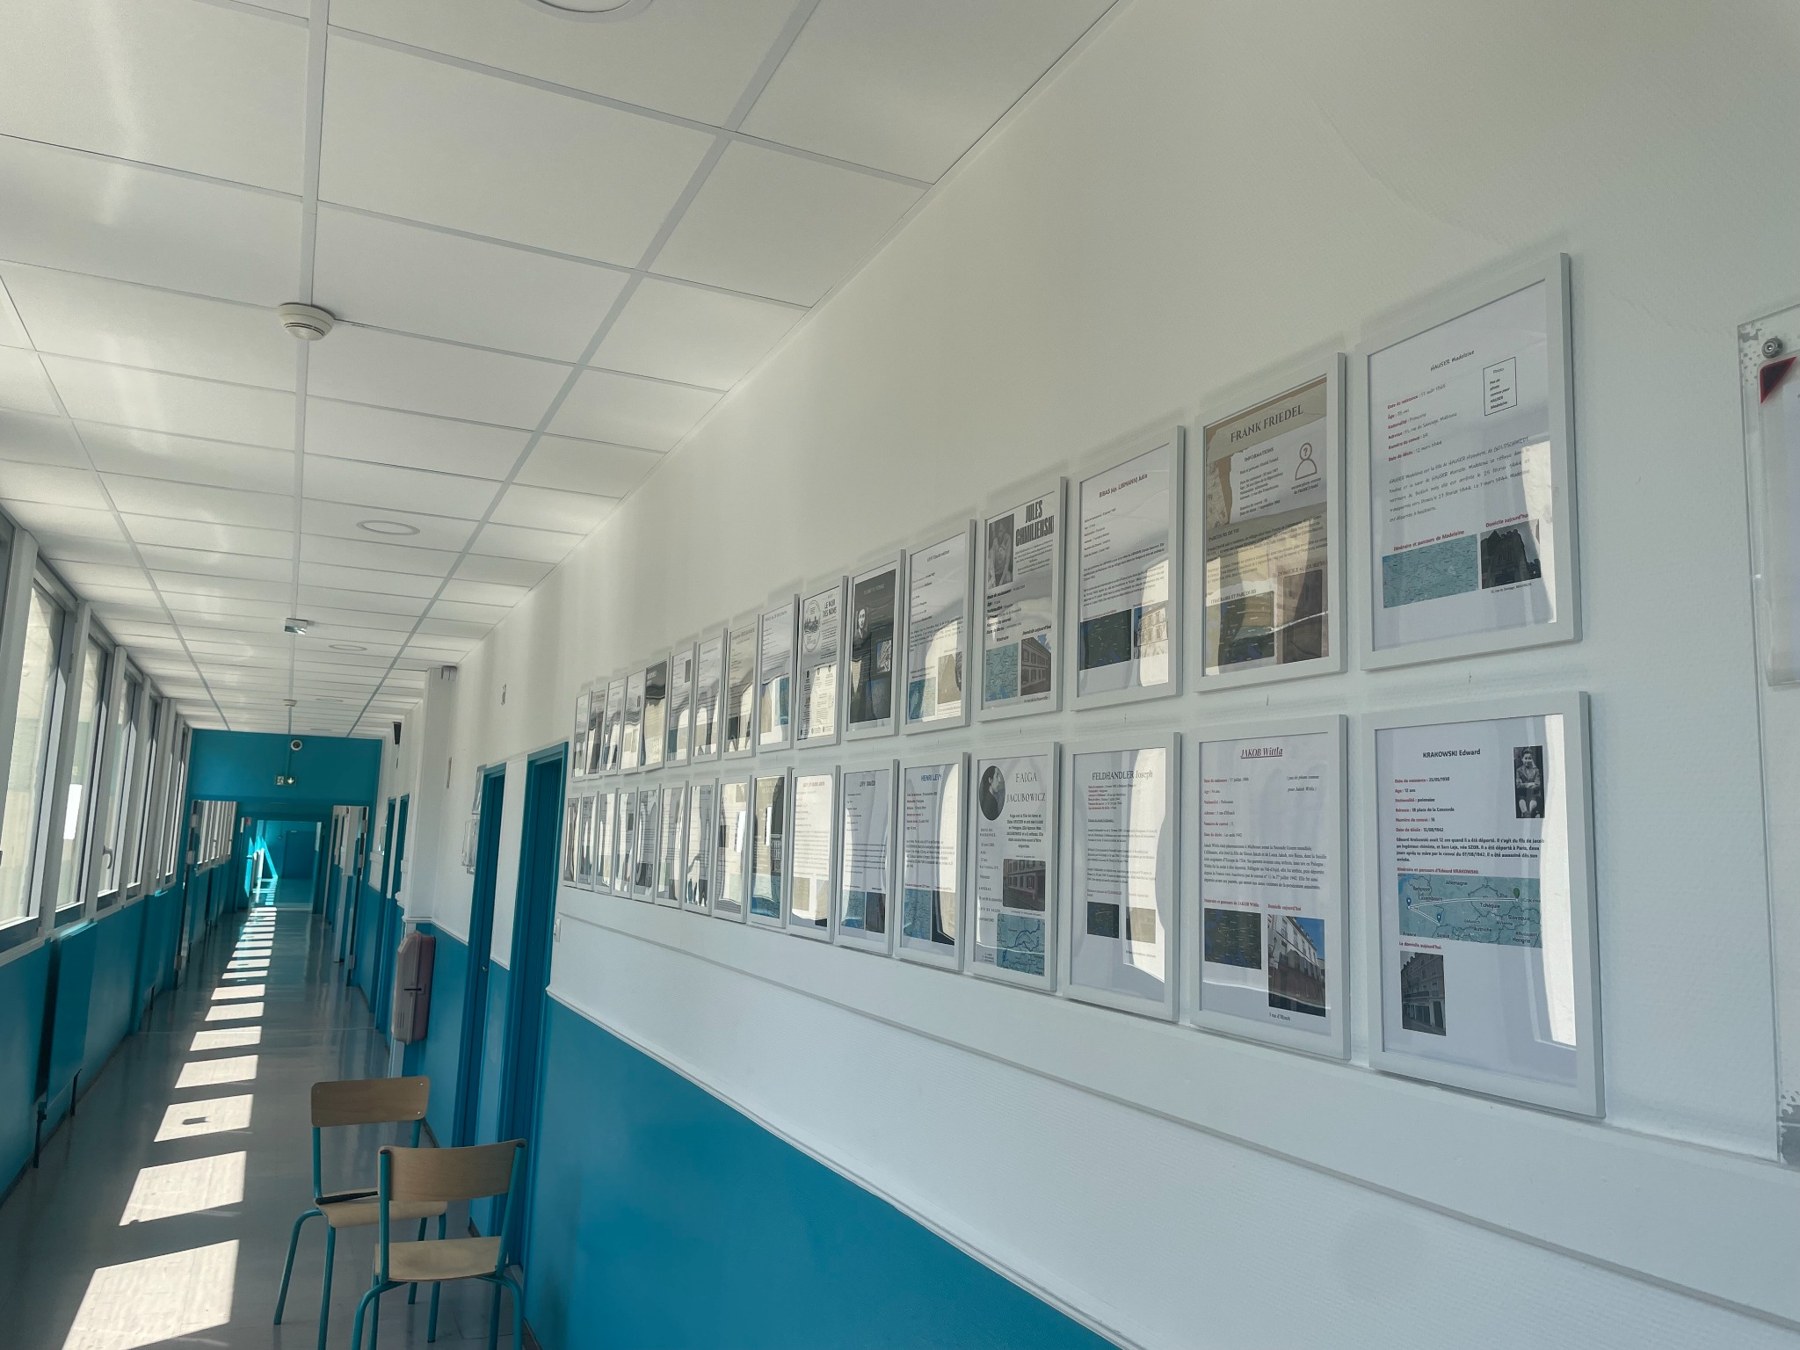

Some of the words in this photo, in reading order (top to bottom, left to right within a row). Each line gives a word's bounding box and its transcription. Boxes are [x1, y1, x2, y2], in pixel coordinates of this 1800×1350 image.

[1231, 422, 1261, 442] FRANK
[1264, 405, 1303, 429] FRIEDEL
[1245, 447, 1274, 461] INFORMATIONS
[1026, 499, 1043, 523] JULES
[1442, 531, 1464, 539] Madeleine
[1241, 749, 1261, 758] JAKOB
[1016, 772, 1037, 782] FAIGA
[1136, 770, 1152, 779] Joseph
[1007, 793, 1045, 802] JACUBOWICZ
